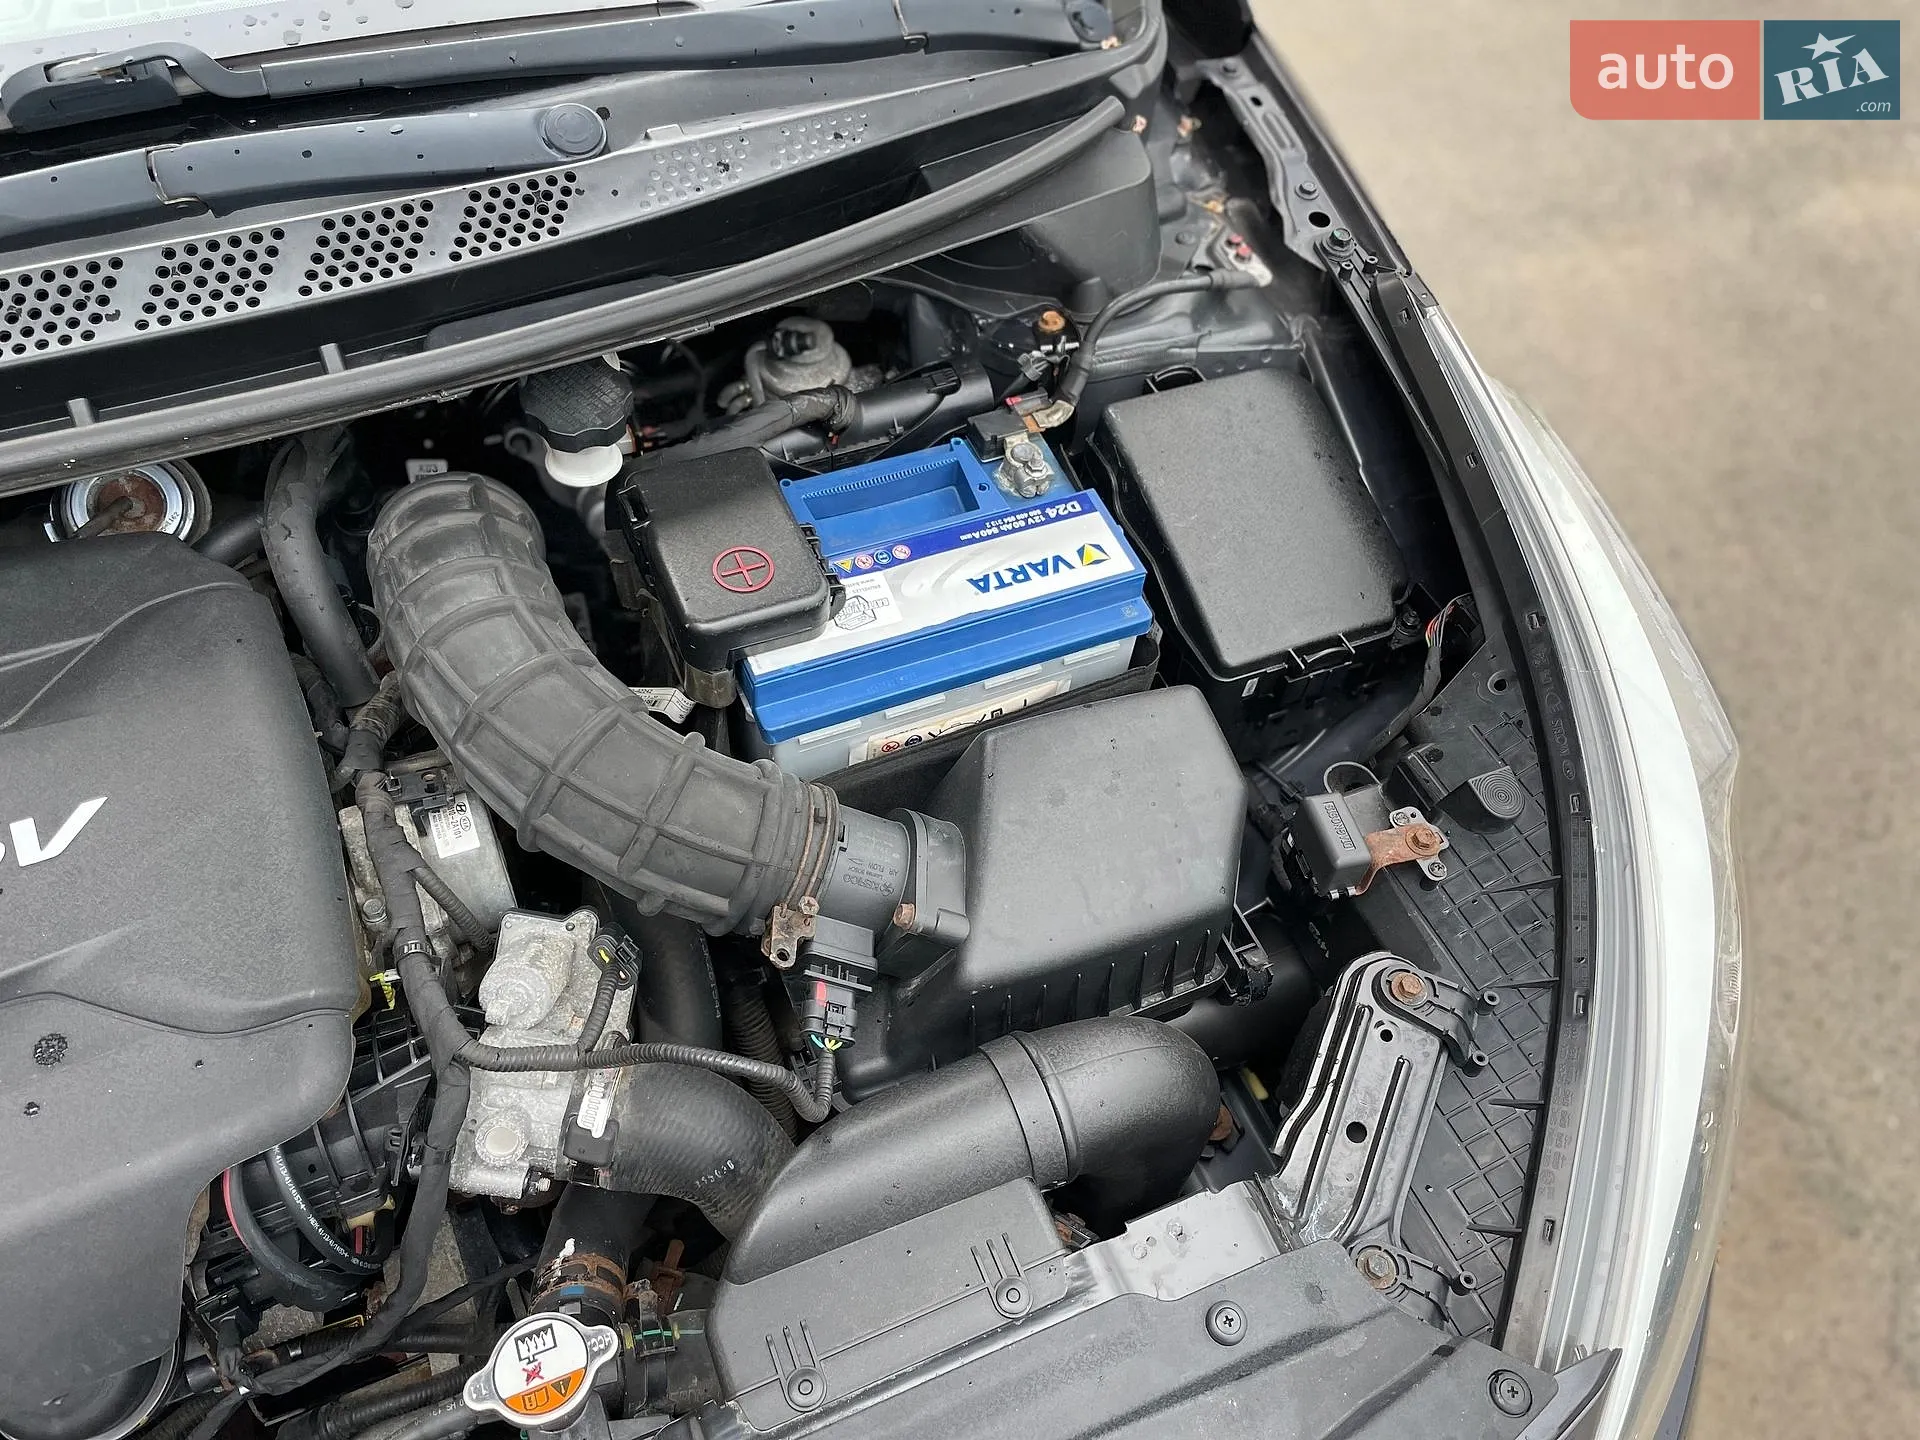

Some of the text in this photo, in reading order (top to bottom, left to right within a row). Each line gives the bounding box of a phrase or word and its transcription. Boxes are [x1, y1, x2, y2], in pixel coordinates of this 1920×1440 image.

[1045, 500, 1081, 519] D24
[1027, 514, 1046, 525] 12V
[967, 554, 1075, 594] VARTA
